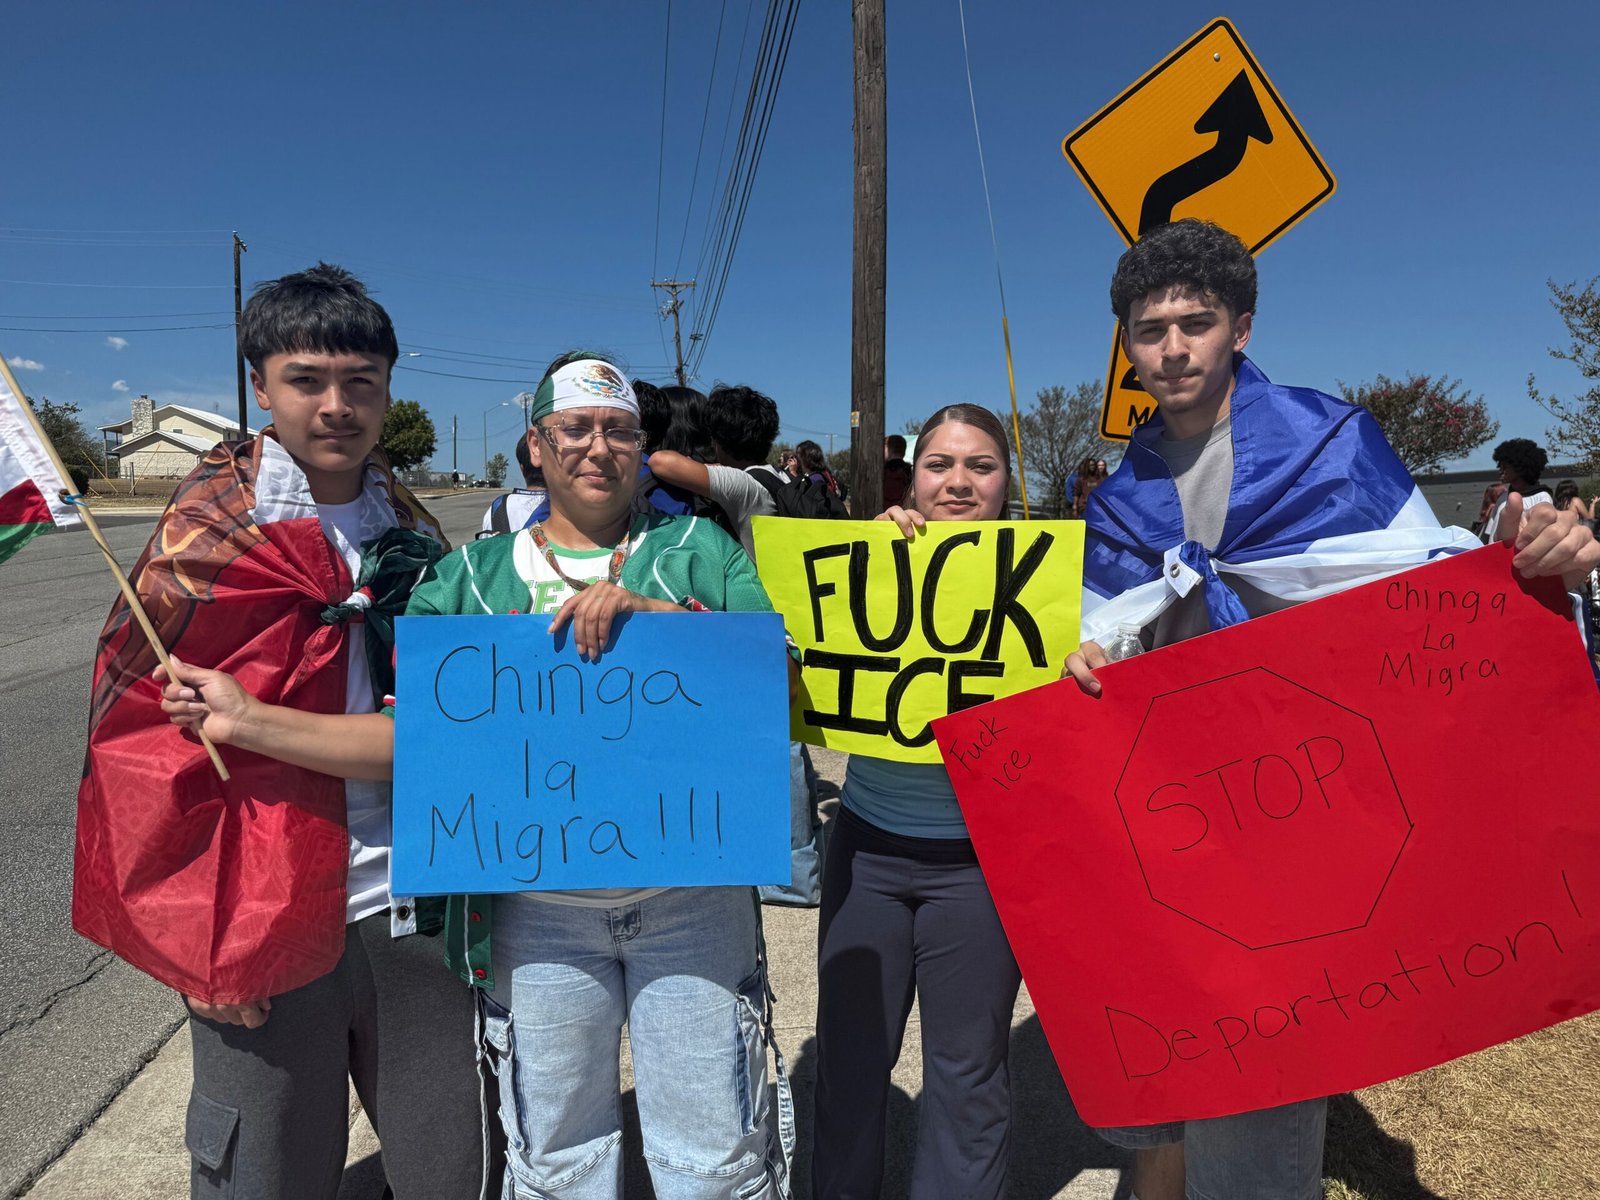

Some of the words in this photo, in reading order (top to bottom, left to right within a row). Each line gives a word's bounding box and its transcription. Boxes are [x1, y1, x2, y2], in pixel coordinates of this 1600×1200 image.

[803, 528, 1055, 667] FUCK
[1386, 580, 1507, 624] Chinga
[1378, 651, 1500, 696] Migra
[1422, 623, 1455, 651] La
[435, 643, 702, 740] Chinga
[803, 648, 1006, 747] ICE
[949, 716, 1008, 772] Fuck
[1146, 735, 1345, 852] STOP
